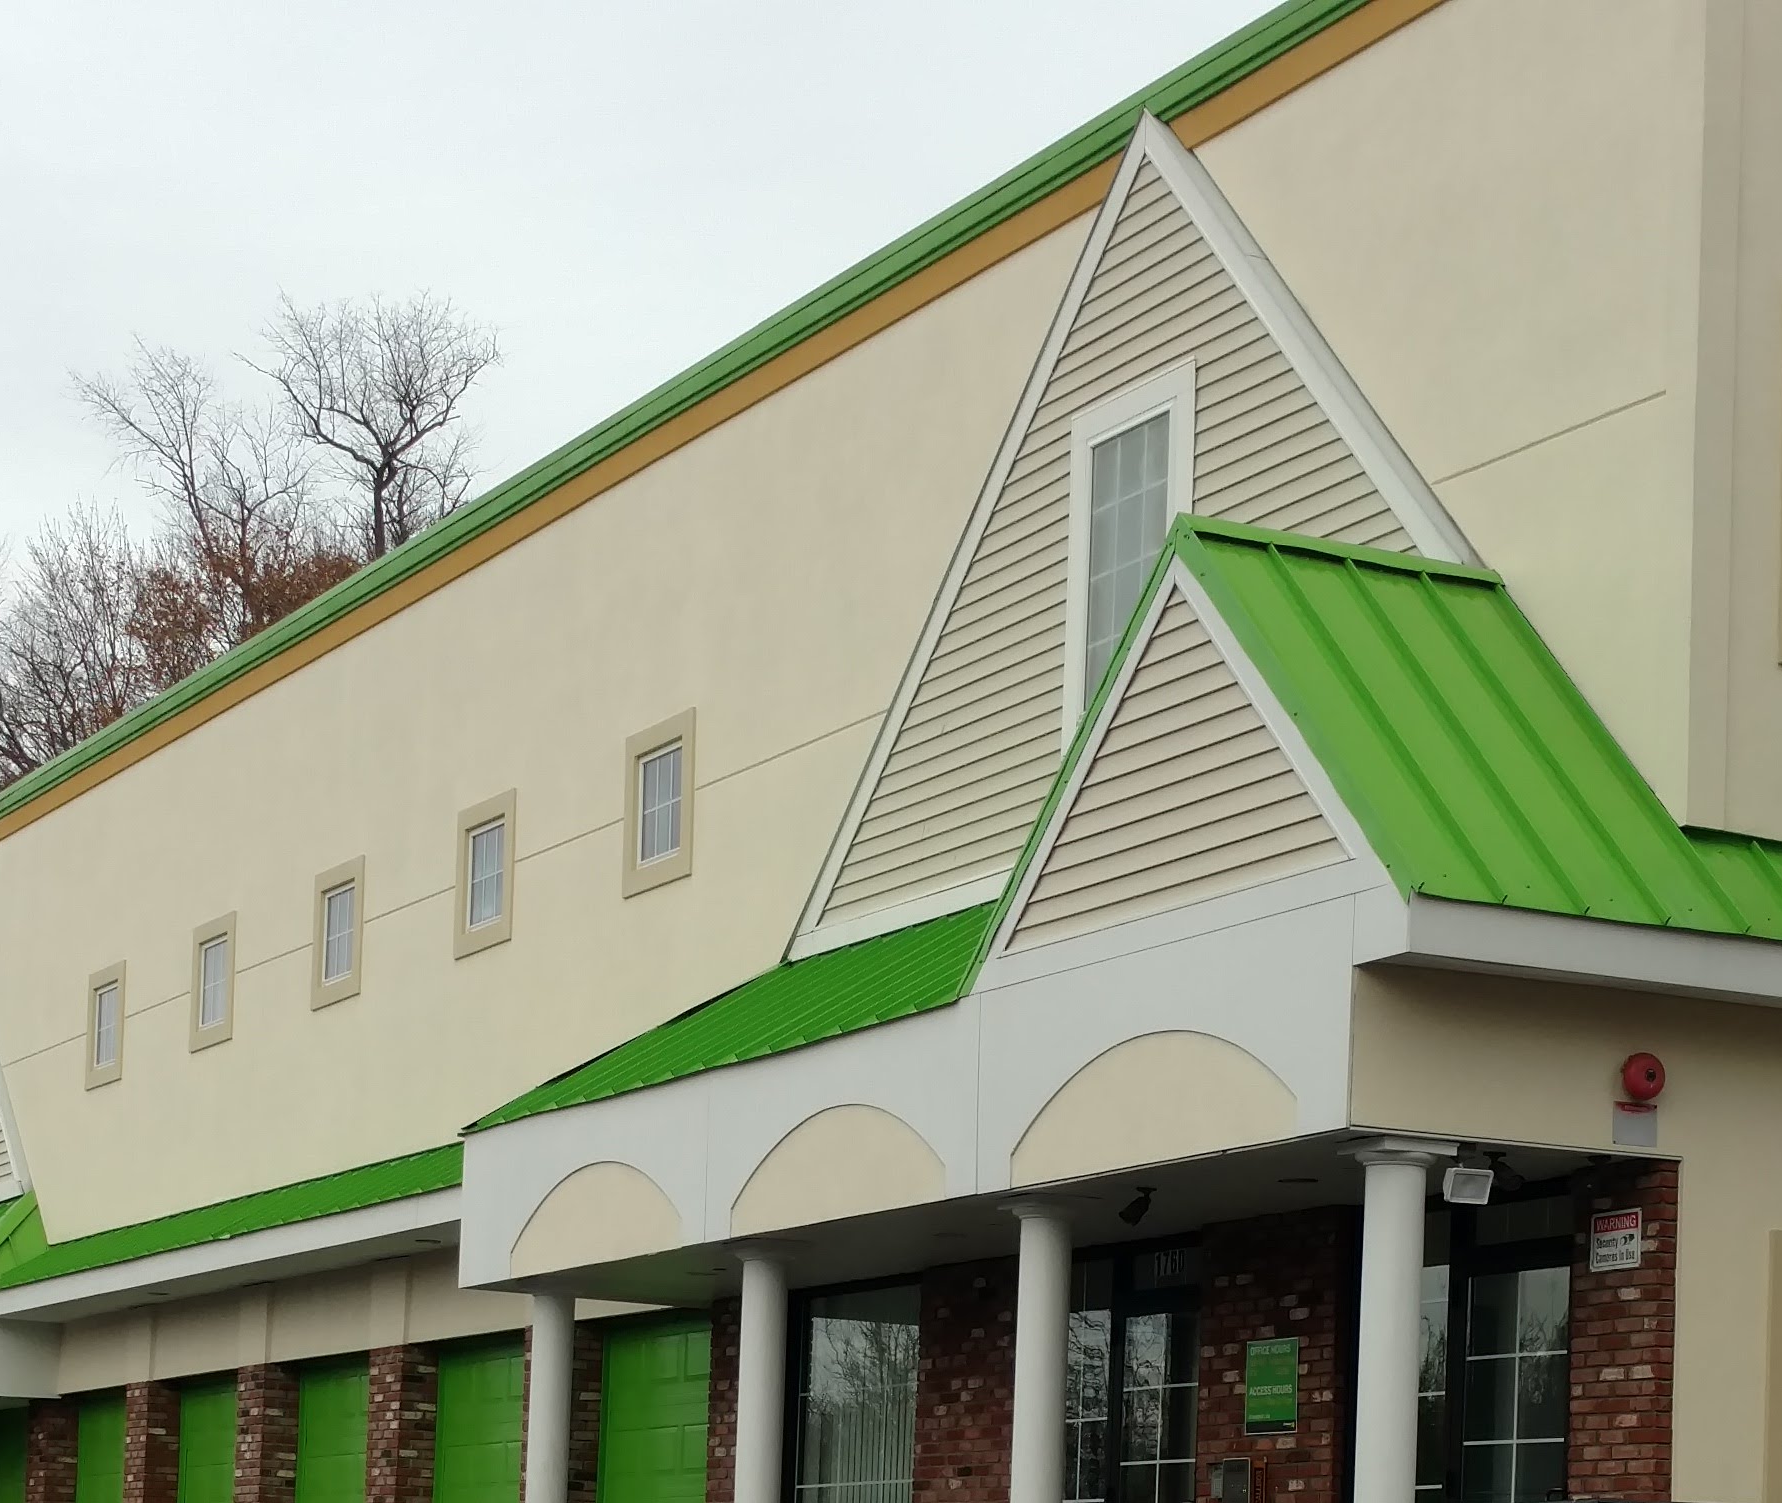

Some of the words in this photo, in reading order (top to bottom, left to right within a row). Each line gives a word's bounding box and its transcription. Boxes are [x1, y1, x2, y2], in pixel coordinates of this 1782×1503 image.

[1596, 1214, 1637, 1232] WARNING
[1249, 1385, 1272, 1396] ACCESS
[1272, 1383, 1293, 1395] HOURS
